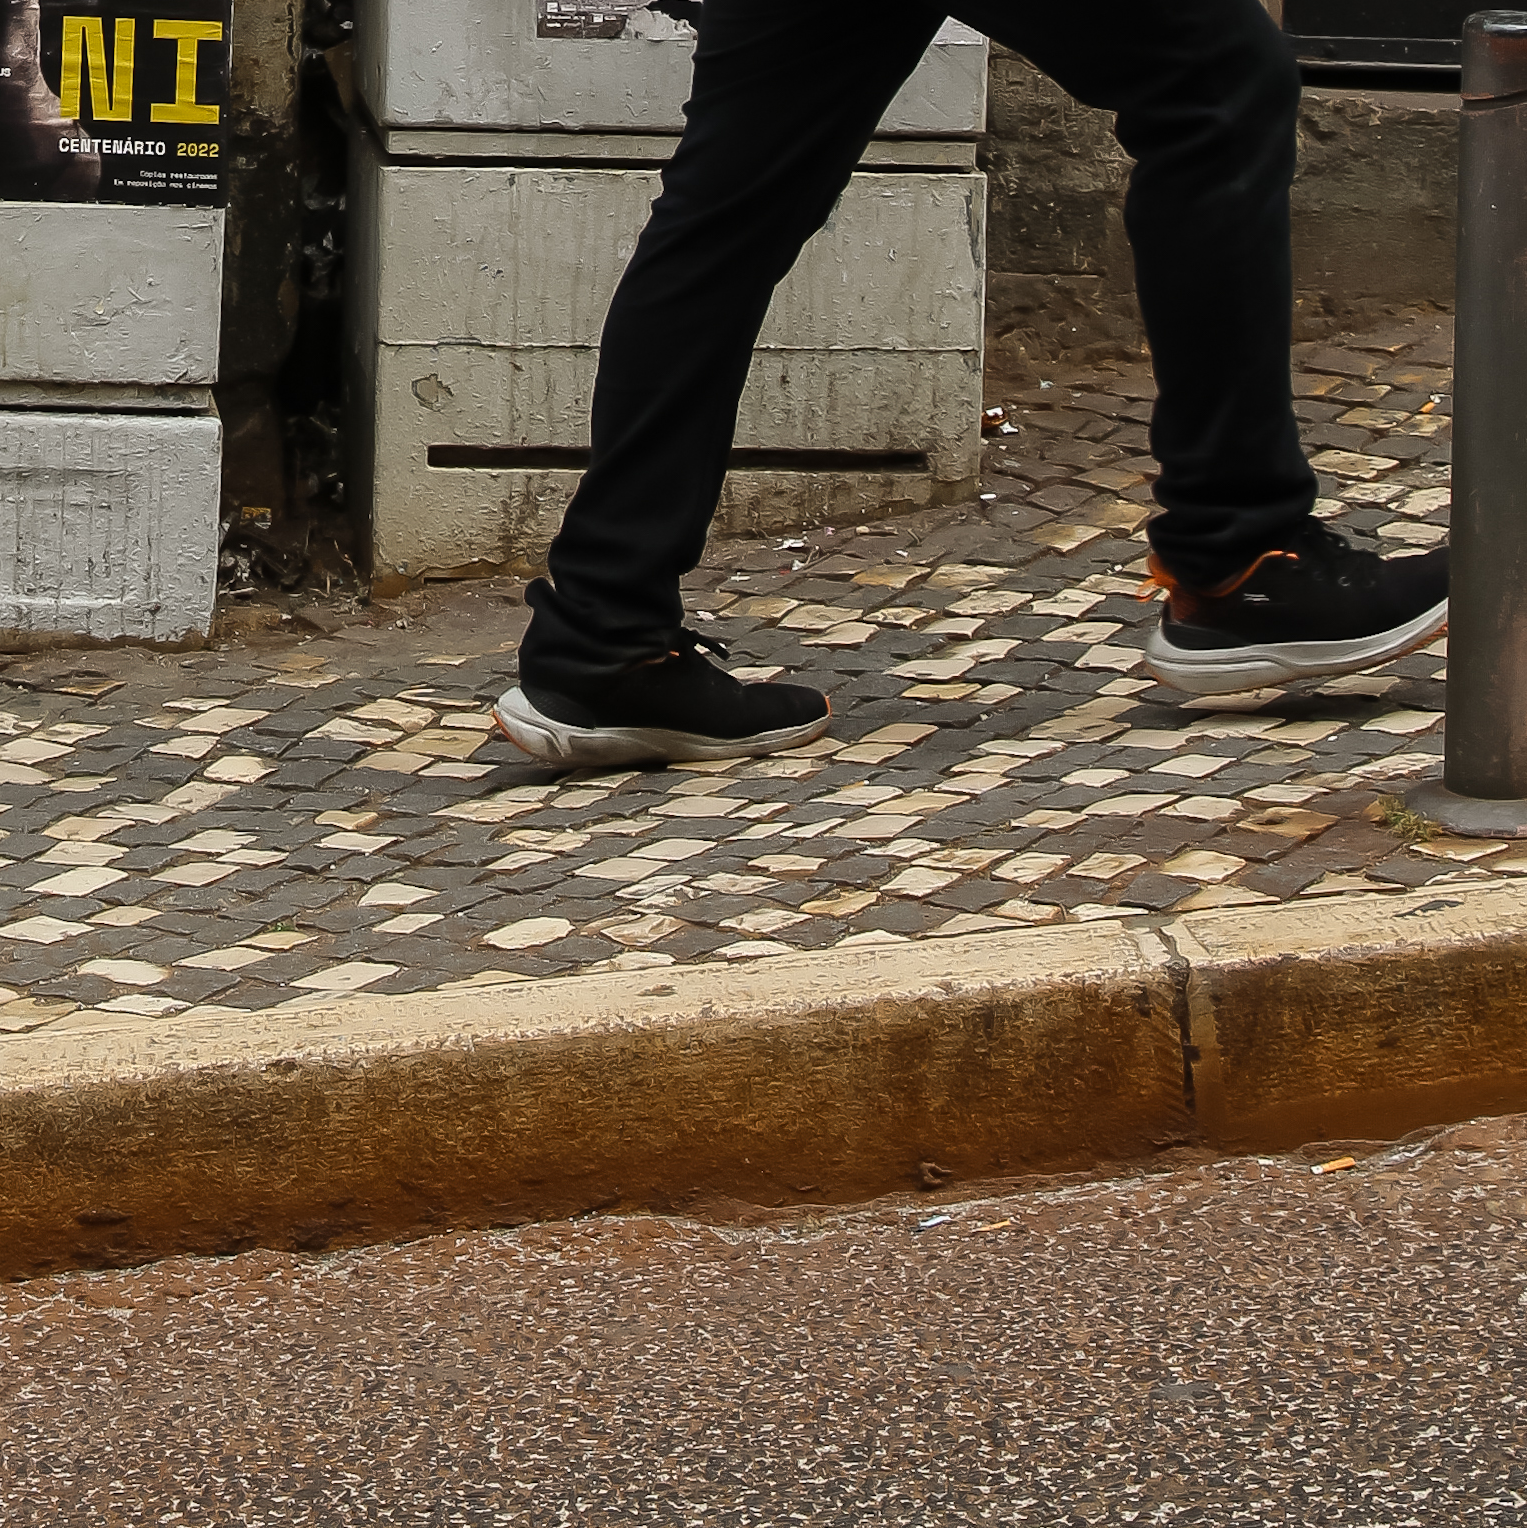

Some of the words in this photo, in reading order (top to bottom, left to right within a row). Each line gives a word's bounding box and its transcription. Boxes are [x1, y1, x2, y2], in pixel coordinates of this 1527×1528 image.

[59, 14, 224, 126] NI
[58, 136, 166, 157] CENTENÁRIO
[176, 142, 221, 158] 2022
